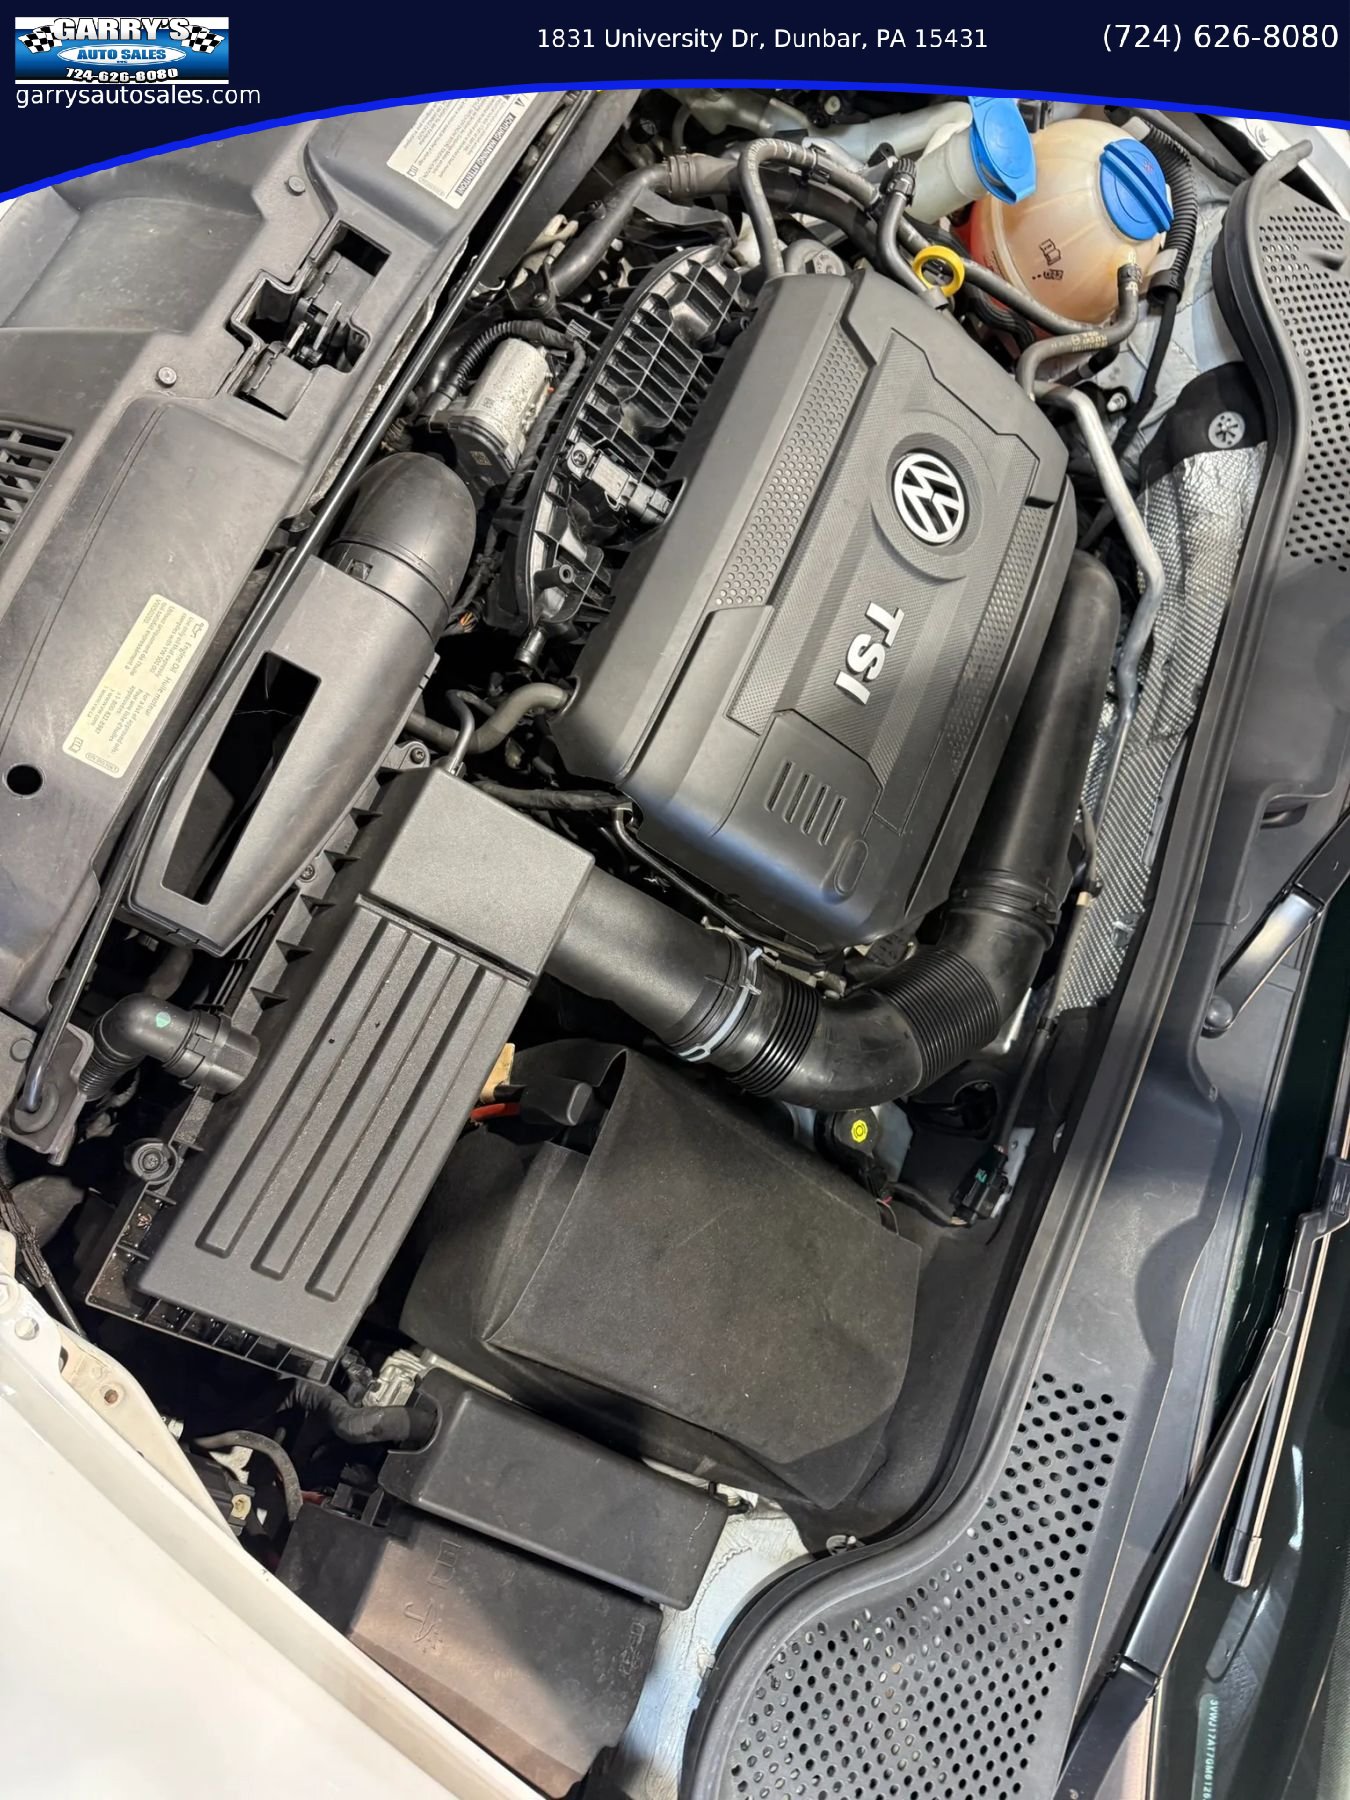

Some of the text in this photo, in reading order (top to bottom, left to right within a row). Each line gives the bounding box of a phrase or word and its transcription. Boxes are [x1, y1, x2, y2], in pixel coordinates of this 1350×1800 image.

[169, 640, 191, 673] Engine Oil
[834, 601, 905, 706] TSI
